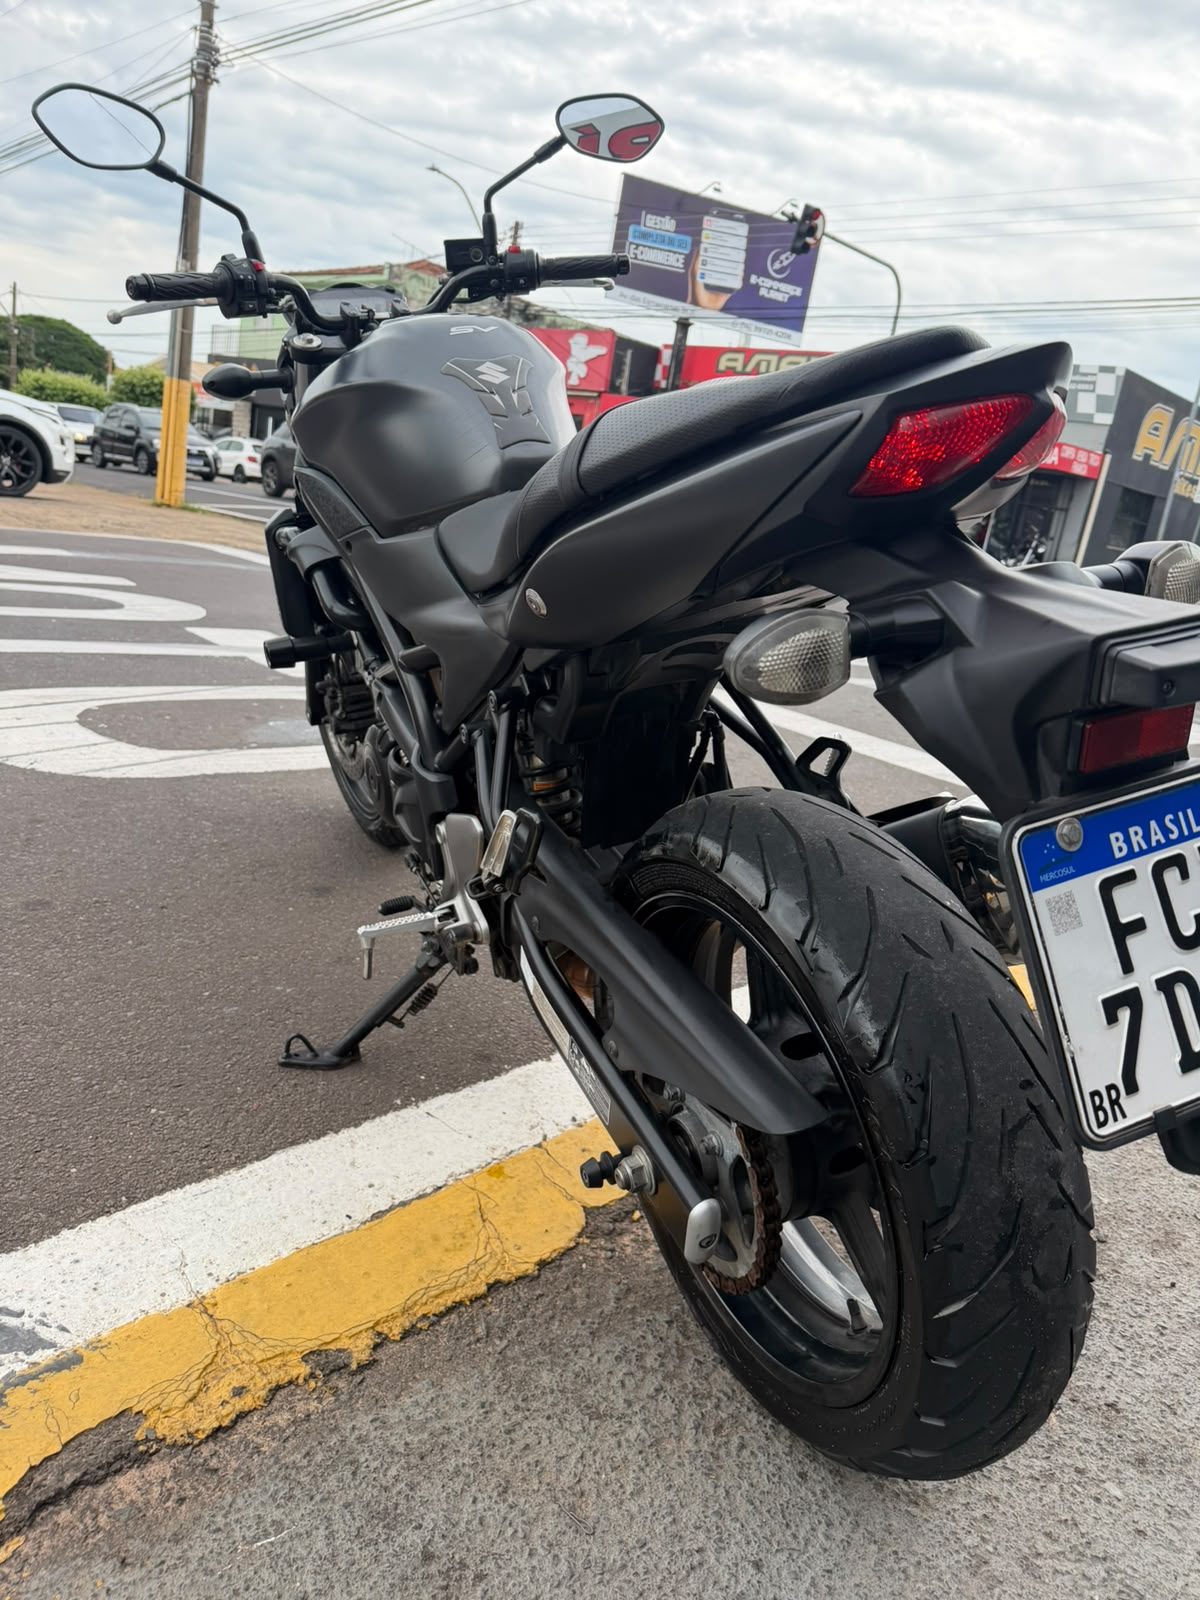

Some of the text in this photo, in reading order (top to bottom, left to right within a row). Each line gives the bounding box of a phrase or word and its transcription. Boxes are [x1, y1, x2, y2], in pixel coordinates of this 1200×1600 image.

[630, 244, 686, 268] E-COMMERCE
[449, 325, 499, 336] SV
[1109, 808, 1200, 859] BRASIL
[1039, 865, 1076, 883] MERCOSUL
[1098, 846, 1200, 976] FC
[1089, 1083, 1127, 1130] BR
